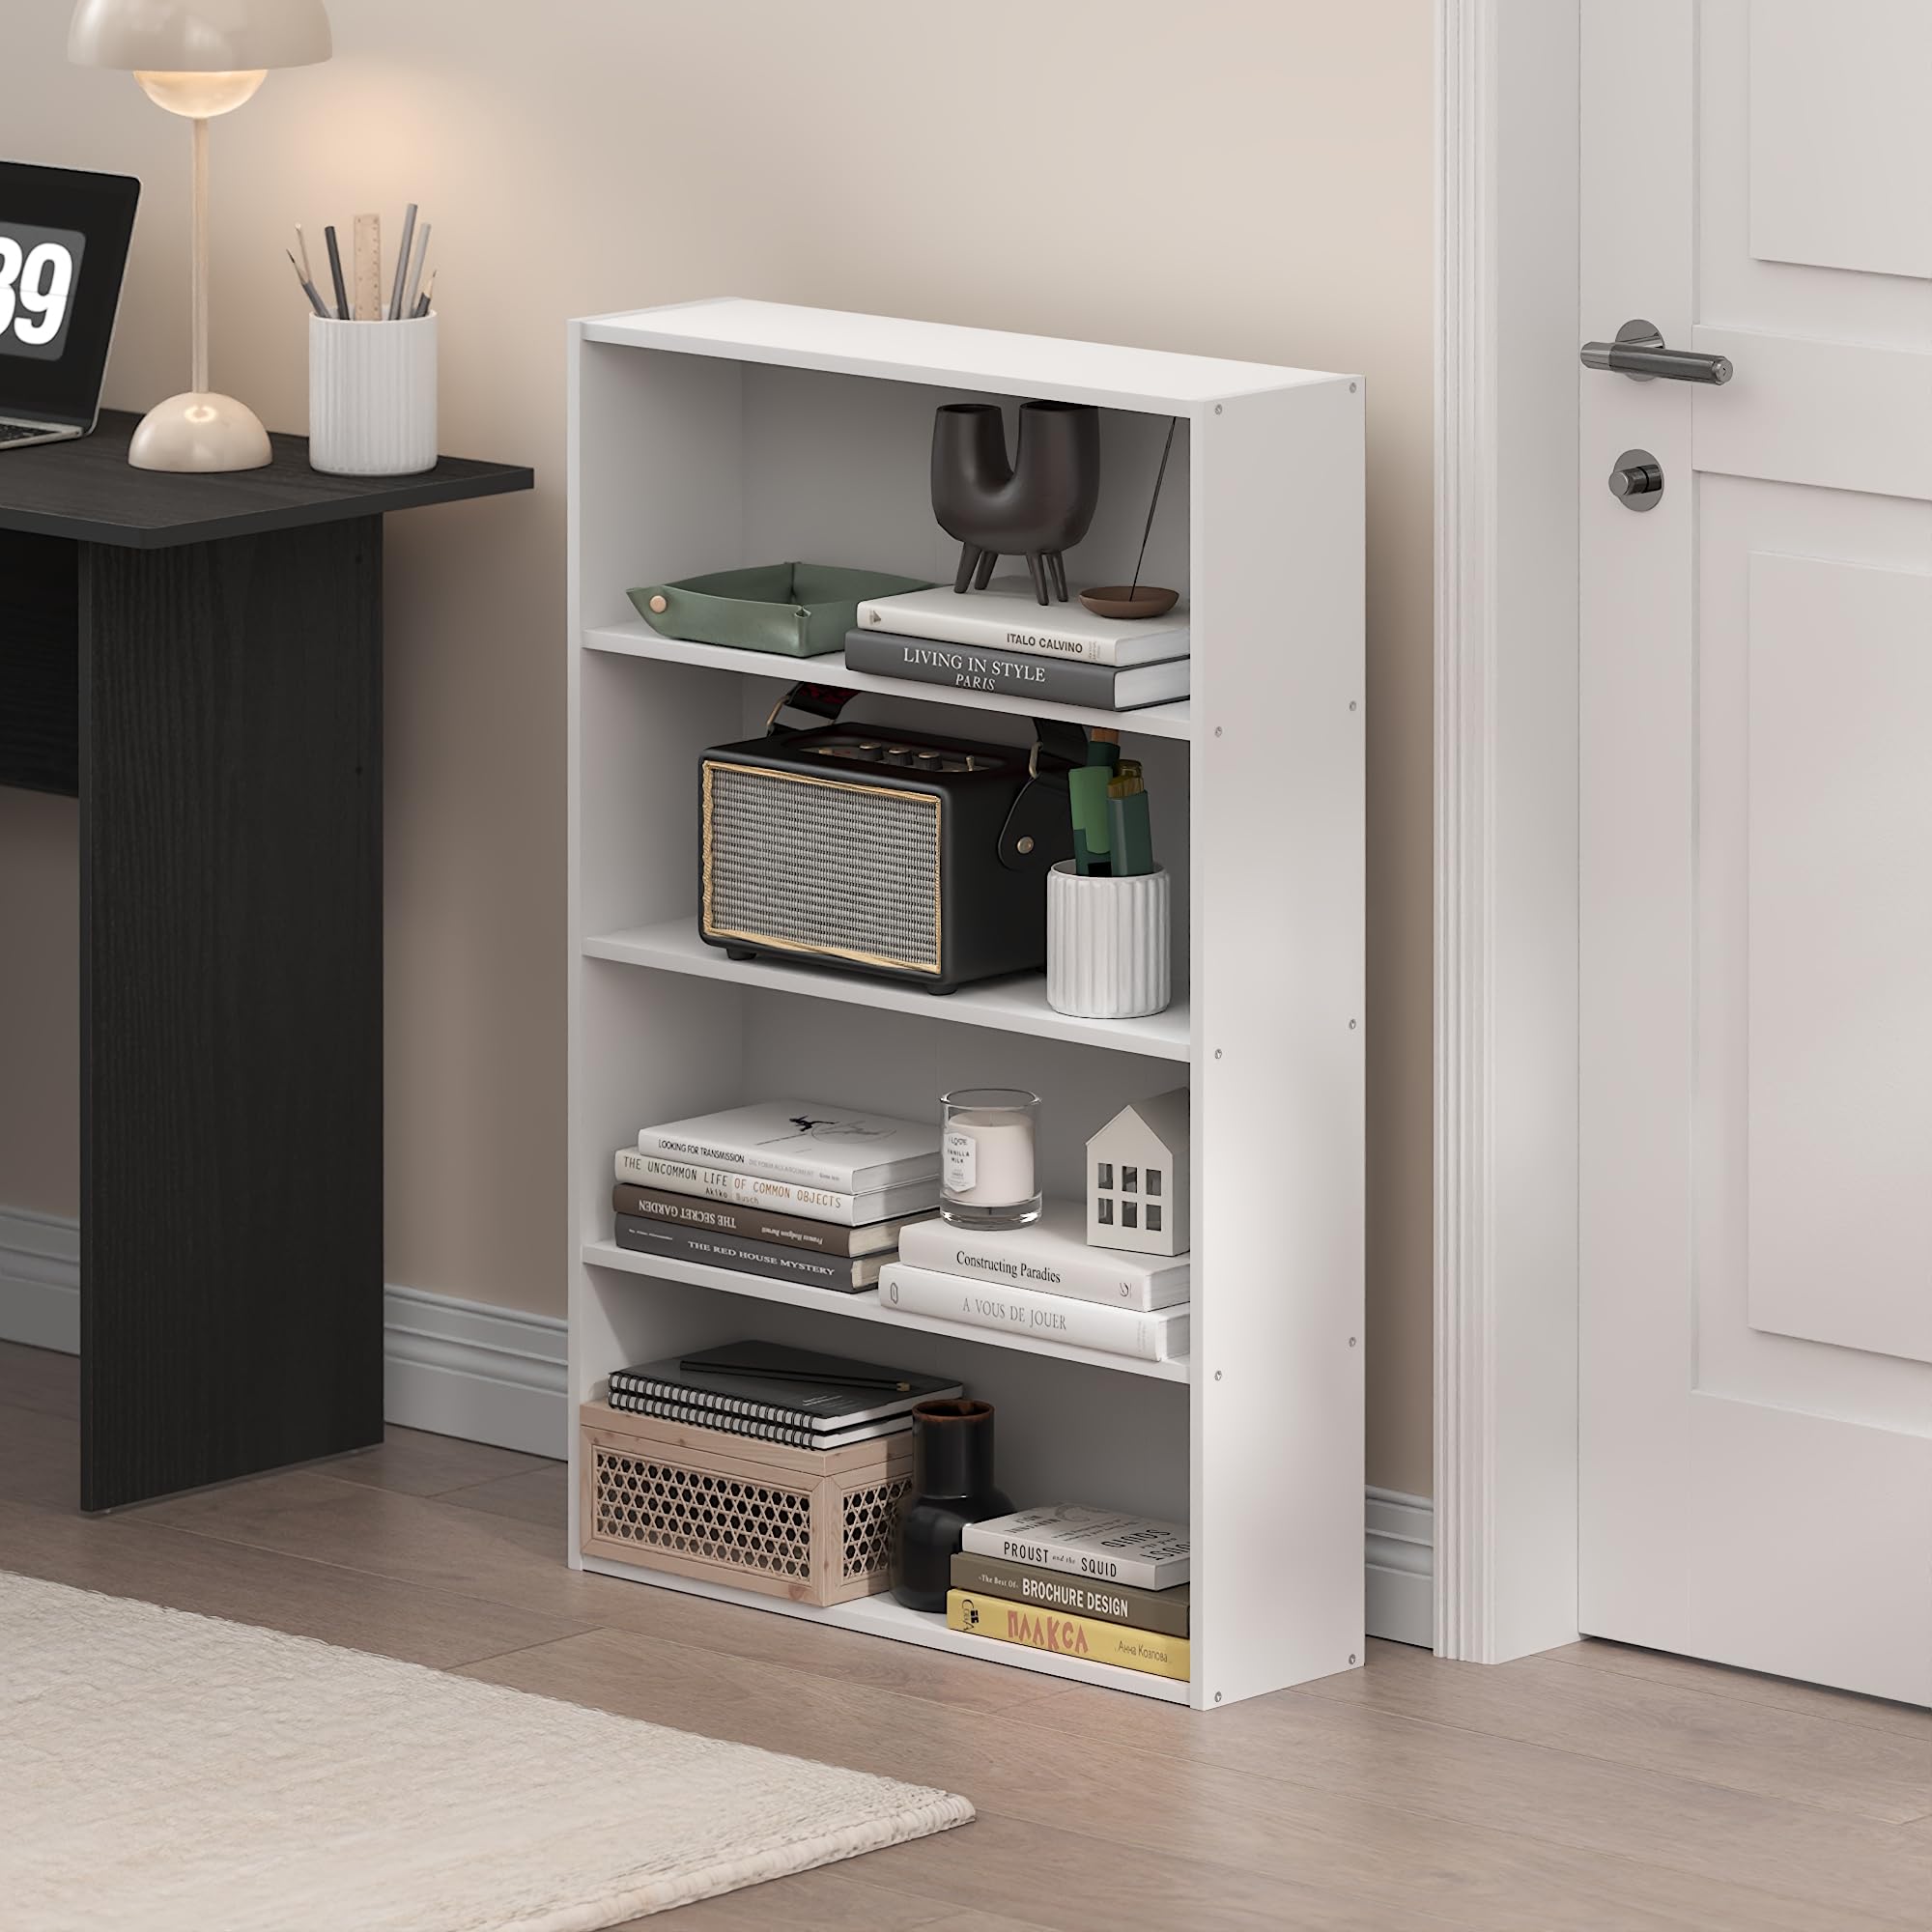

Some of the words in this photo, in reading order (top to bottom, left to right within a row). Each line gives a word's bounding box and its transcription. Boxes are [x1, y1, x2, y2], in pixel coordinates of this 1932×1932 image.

[1007, 633, 1036, 647] ITALO
[1038, 638, 1083, 653] CALVINO
[903, 647, 963, 669] LIVING
[968, 656, 987, 673] IN
[992, 661, 1045, 683] STYLE
[955, 673, 995, 692] PARIS
[658, 1138, 687, 1153] LOOKING
[687, 1144, 699, 1155] FOR
[699, 1147, 745, 1163] TRANSMISSION
[623, 1155, 641, 1170] THE
[647, 1159, 697, 1181] UNCOMMON
[704, 1171, 727, 1187] LIFE
[734, 1178, 747, 1189] OF
[753, 1181, 791, 1199] COMMON
[797, 1189, 841, 1208] OBJECTS
[705, 1186, 728, 1199] Akiko
[735, 1192, 759, 1205] Busch
[639, 1199, 678, 1218] GARDEN
[679, 1208, 716, 1226] SECRET
[717, 1214, 736, 1229] THE
[688, 1240, 711, 1253] THE
[713, 1245, 736, 1258] RED
[739, 1250, 778, 1264] HOUSE
[780, 1258, 835, 1276] MYSTERY
[956, 1250, 1017, 1278] Constructing
[962, 1297, 971, 1313] A
[976, 1299, 1006, 1320] VOUS
[1009, 1307, 1026, 1322] DE
[1030, 1309, 1066, 1330] JOUER
[1101, 1529, 1171, 1548] SQUID
[1004, 1541, 1049, 1564] PROUST
[1081, 1557, 1117, 1577] SQUID
[993, 1576, 1008, 1587] Best
[1022, 1577, 1084, 1609] BROCHURE
[1087, 1592, 1128, 1618] DESIGN
